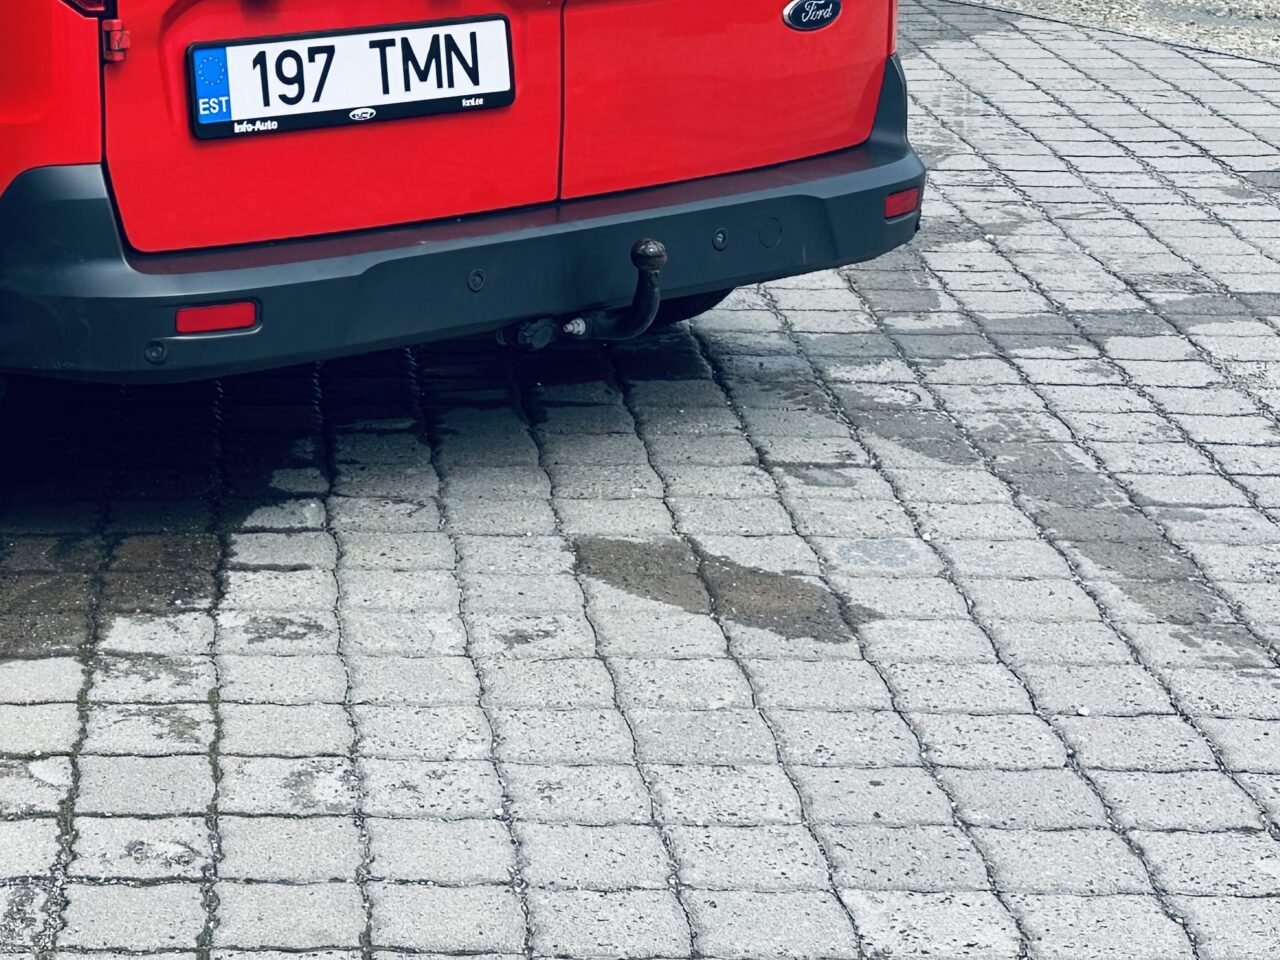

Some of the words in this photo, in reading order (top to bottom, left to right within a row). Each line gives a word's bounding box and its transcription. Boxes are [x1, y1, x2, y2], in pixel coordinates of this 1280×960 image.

[252, 44, 336, 108] 197
[369, 31, 480, 95] TMN
[198, 96, 229, 115] EST
